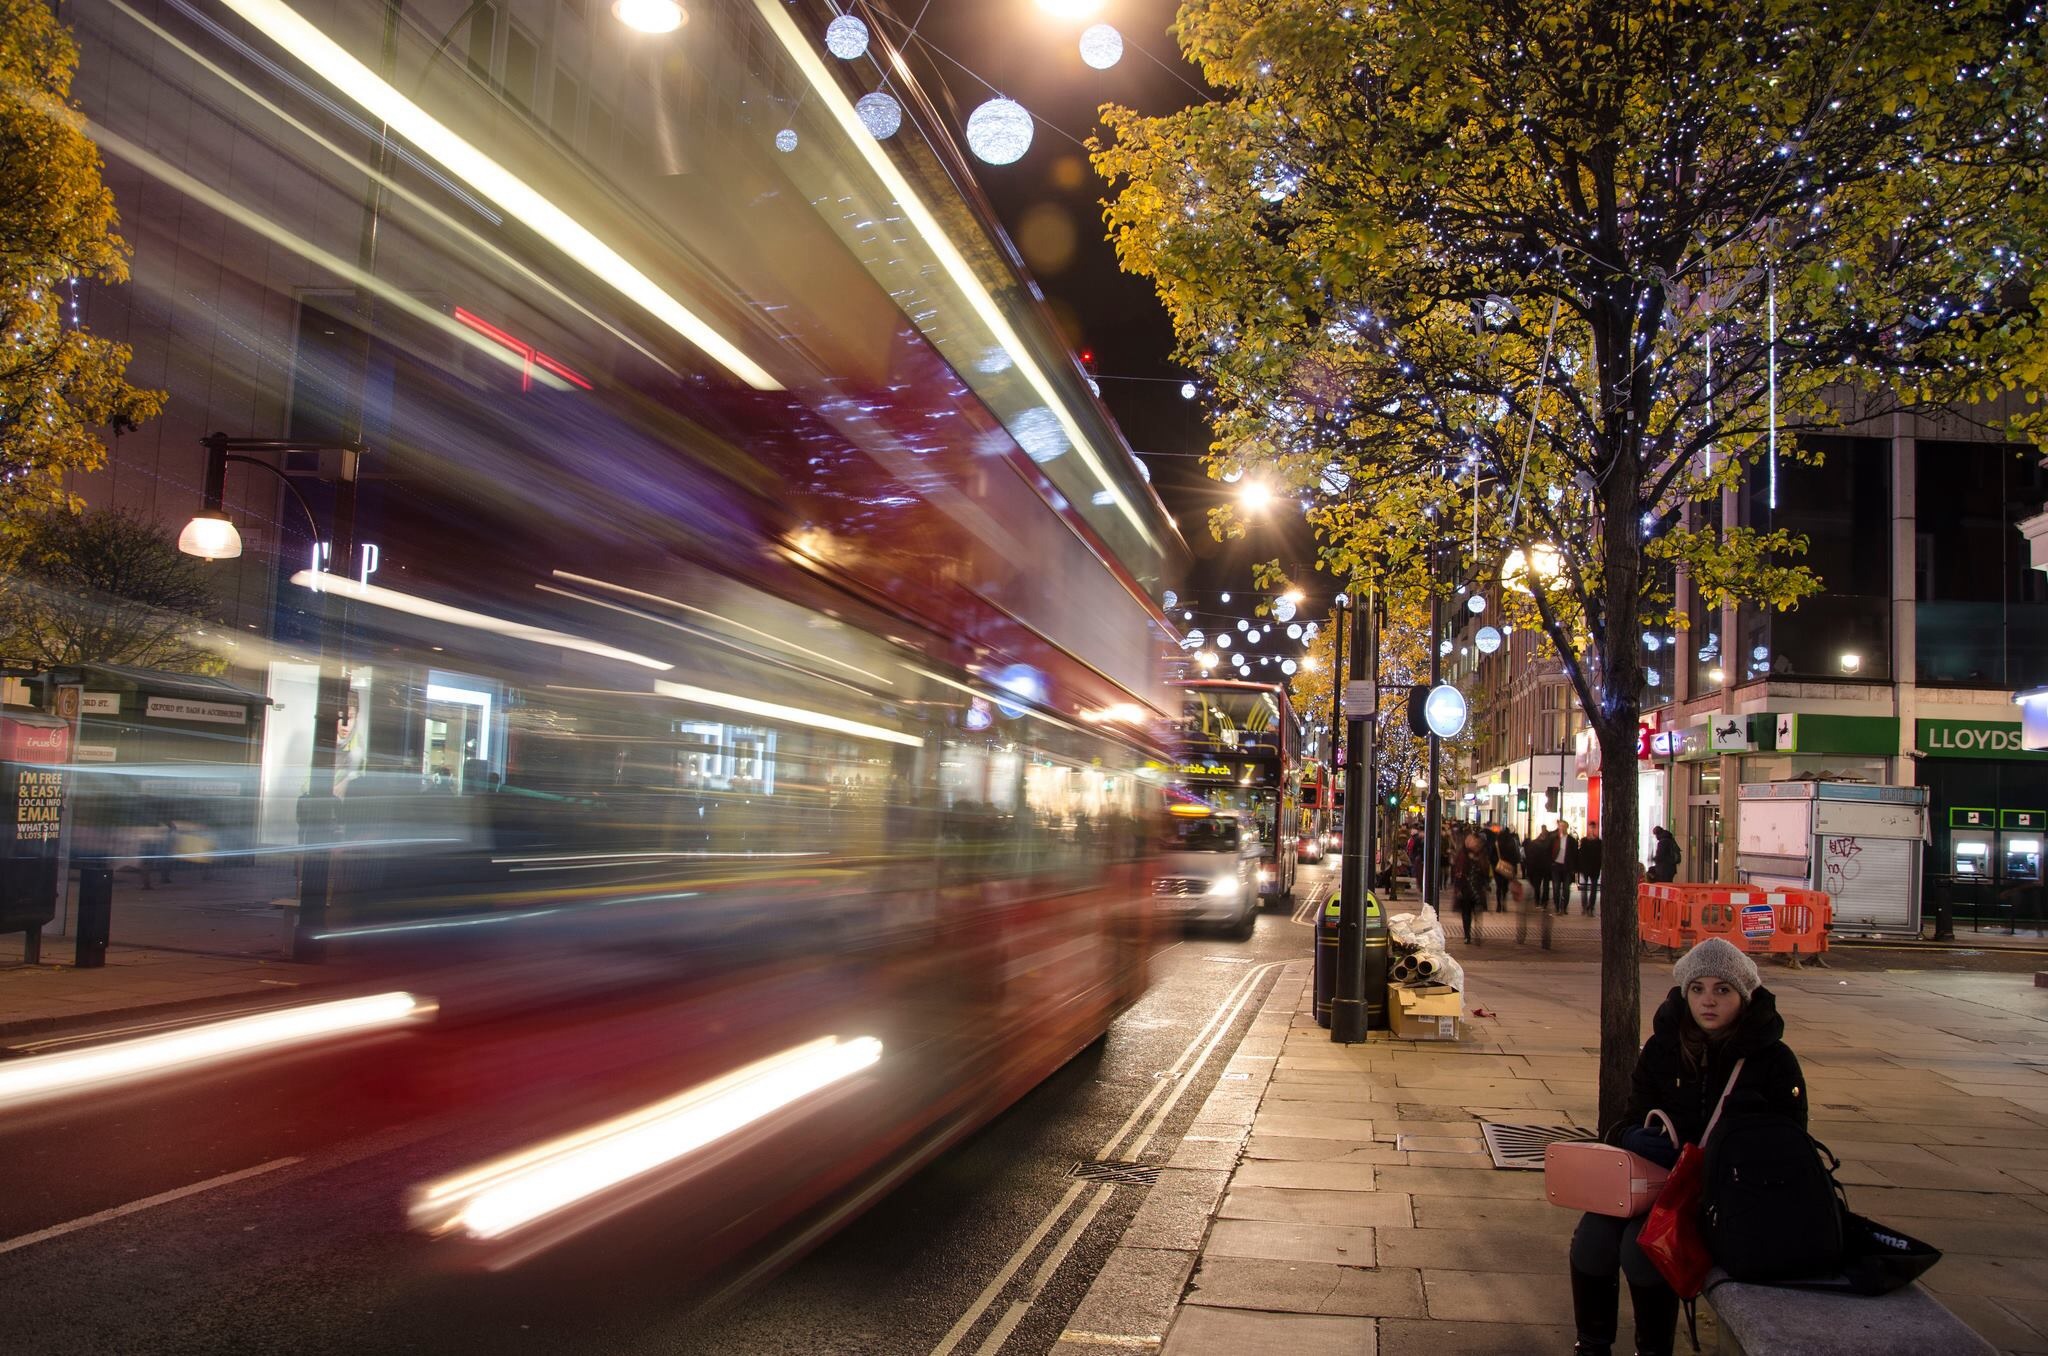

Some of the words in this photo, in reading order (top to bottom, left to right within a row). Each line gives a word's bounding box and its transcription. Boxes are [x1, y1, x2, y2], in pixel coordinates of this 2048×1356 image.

[310, 541, 379, 594] GP
[1929, 728, 2022, 751] LLOYDS
[1208, 764, 1232, 775] Arch
[1244, 763, 1256, 779] 7
[20, 771, 38, 784] I'M
[39, 773, 62, 784] FREE
[19, 785, 29, 798] &
[31, 785, 62, 798] EASY.
[19, 799, 45, 807] LOCAL
[46, 799, 61, 807] INFO
[18, 807, 60, 821] EMAIL
[17, 822, 49, 832] WHAT'S
[49, 823, 59, 831] ON
